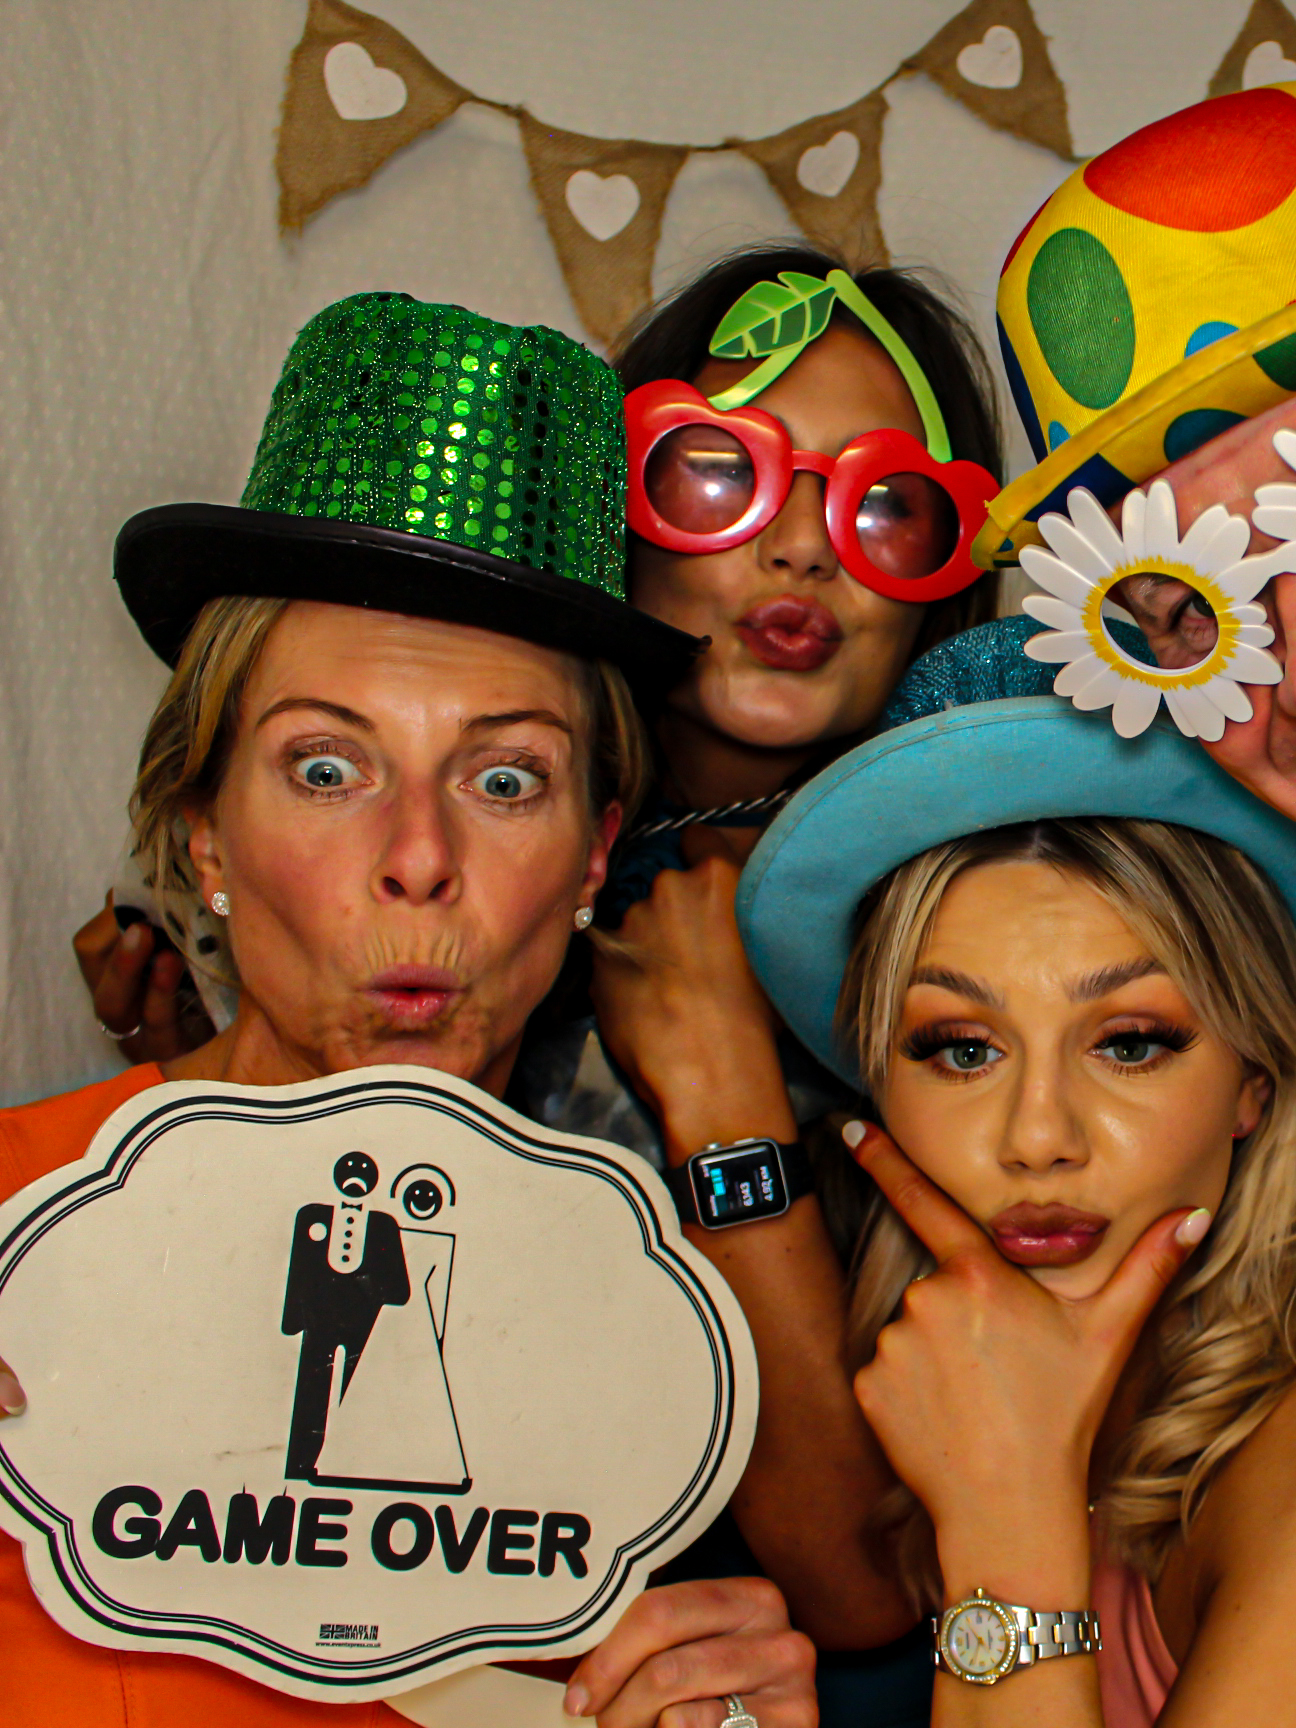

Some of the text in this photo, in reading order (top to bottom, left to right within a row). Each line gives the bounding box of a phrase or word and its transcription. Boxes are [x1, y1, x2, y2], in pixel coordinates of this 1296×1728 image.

[91, 1485, 592, 1579] GAME OVER
[345, 1625, 379, 1633] MADE IN
[344, 1632, 378, 1640] BRITAIN
